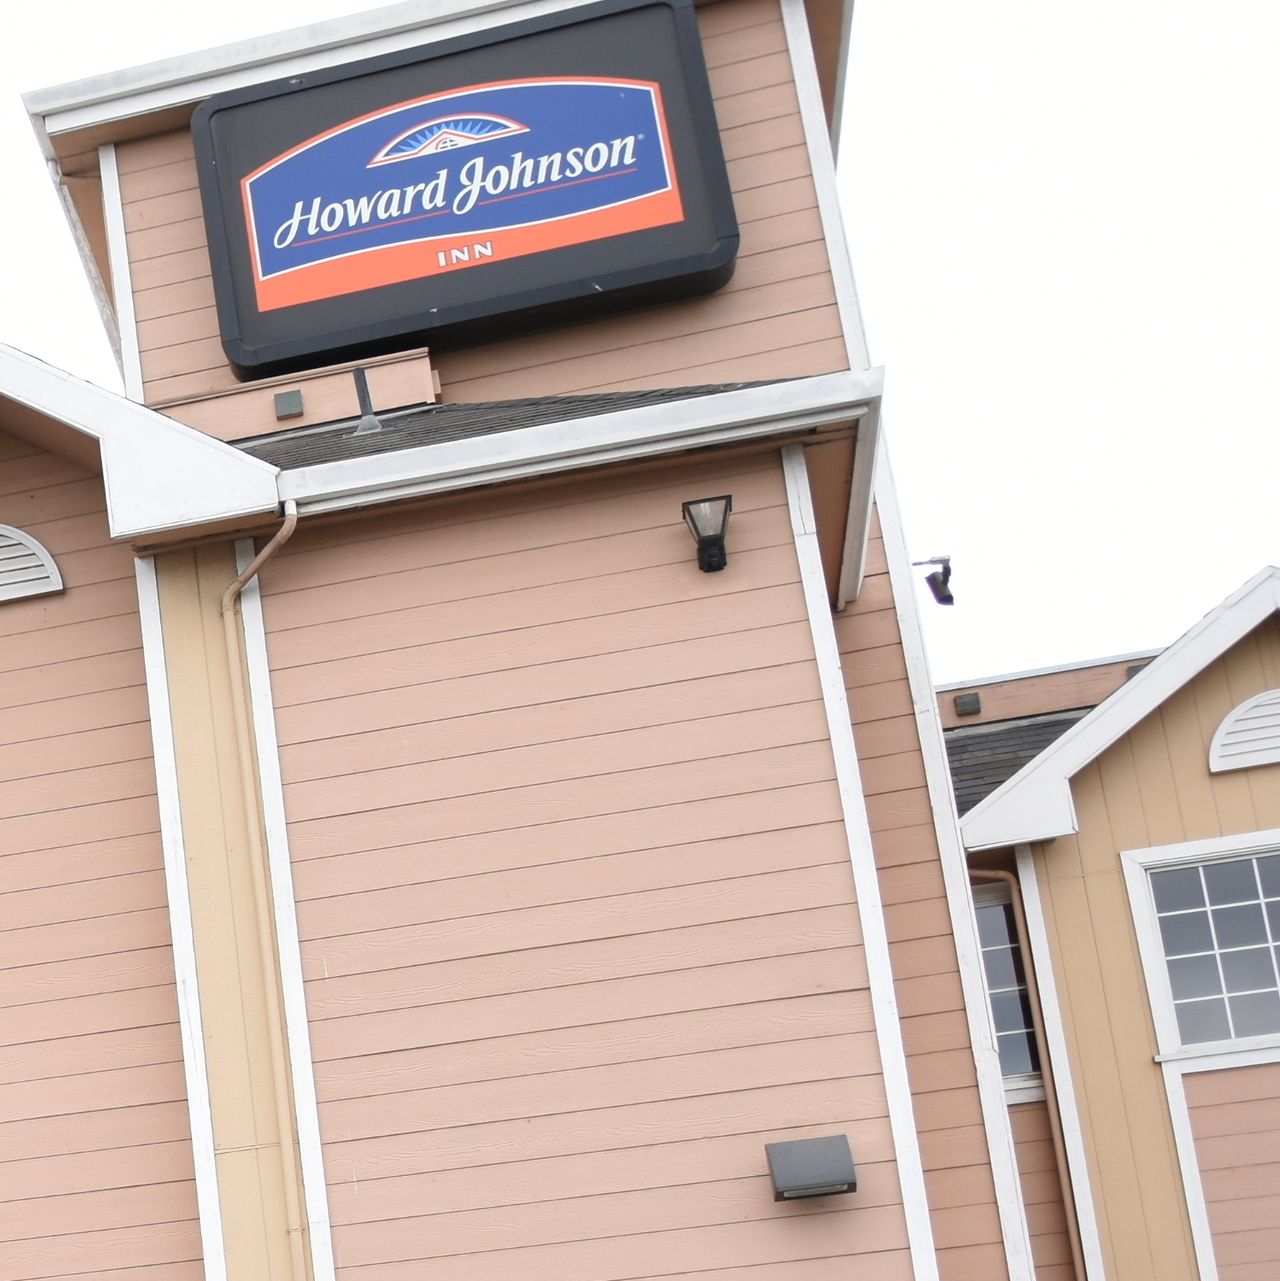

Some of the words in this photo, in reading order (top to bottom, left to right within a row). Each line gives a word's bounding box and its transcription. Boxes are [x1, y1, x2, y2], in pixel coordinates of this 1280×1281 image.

[273, 169, 446, 249] Howard
[452, 134, 636, 215] Johnson
[437, 240, 494, 267] INN
